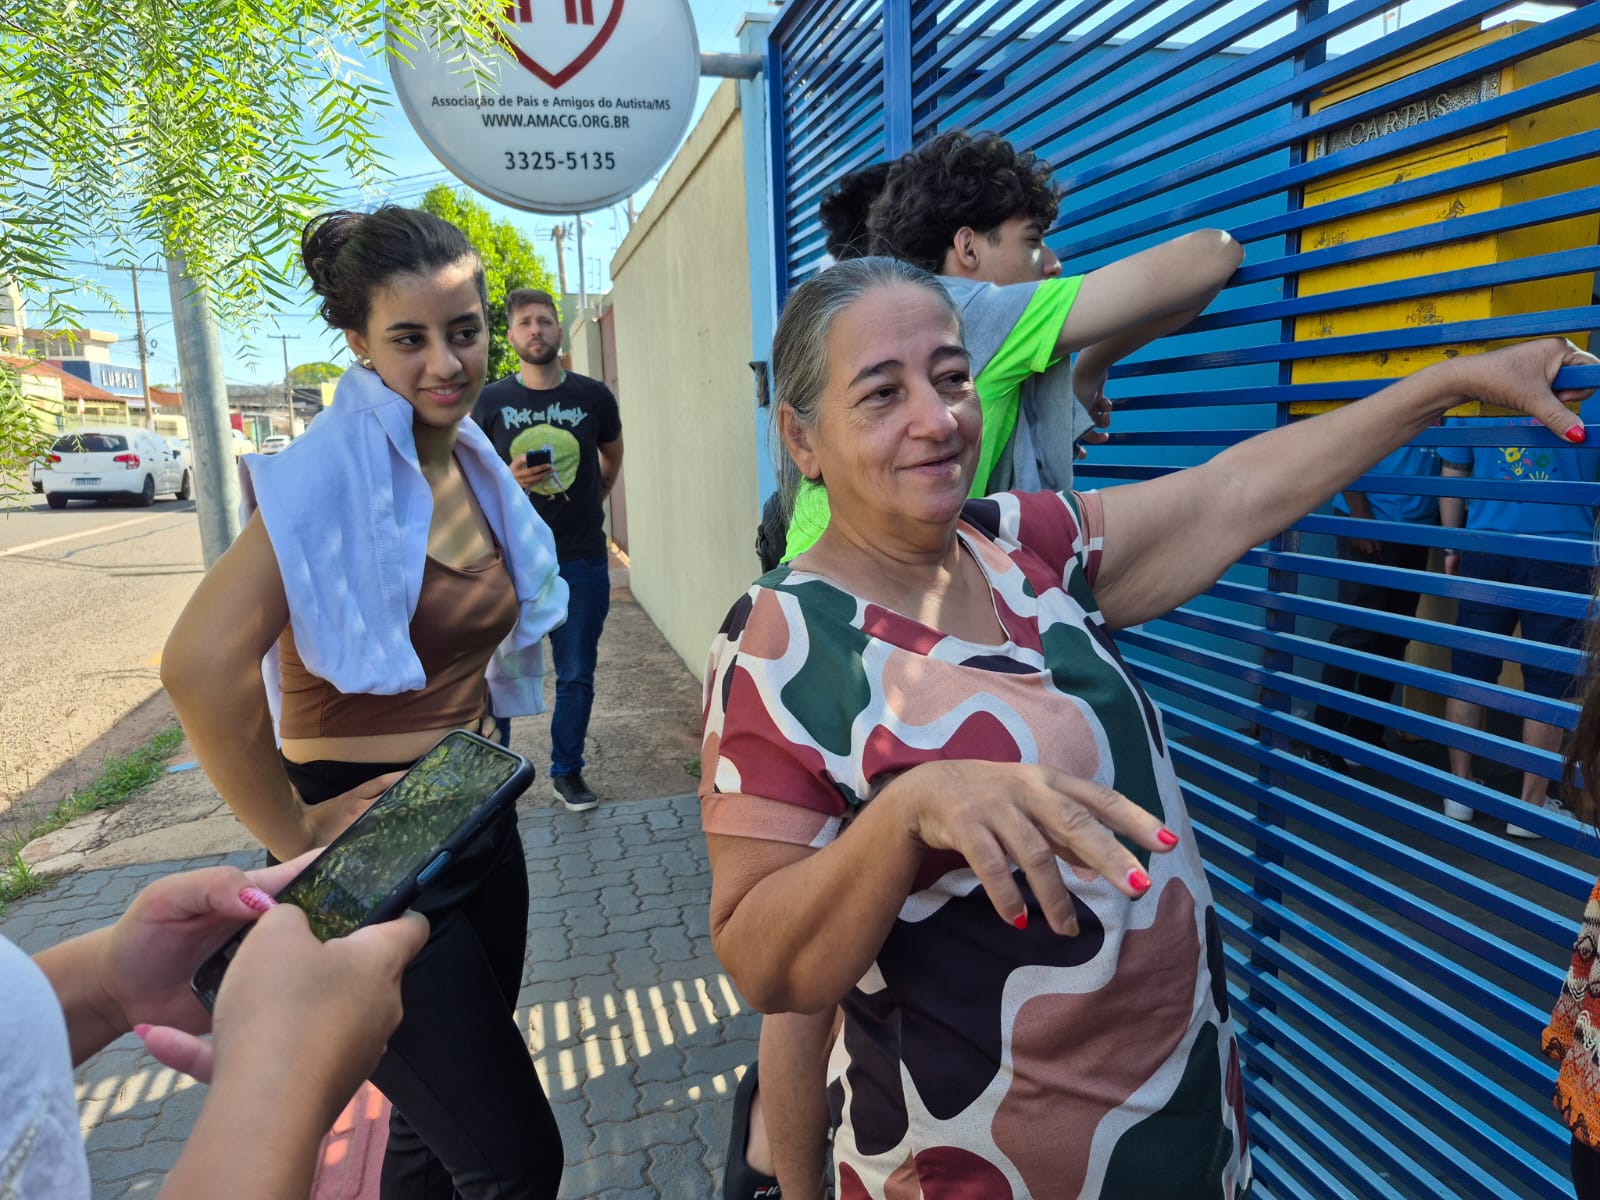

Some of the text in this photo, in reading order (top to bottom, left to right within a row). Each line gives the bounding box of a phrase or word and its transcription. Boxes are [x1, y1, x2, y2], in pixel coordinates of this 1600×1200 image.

[431, 95, 671, 110] Associação de Pais e Amigos do Autista/MS
[482, 113, 630, 129] WWW.AMACG.ORG.BR
[1350, 93, 1450, 146] CARTAS
[504, 151, 616, 170] 3325-5135
